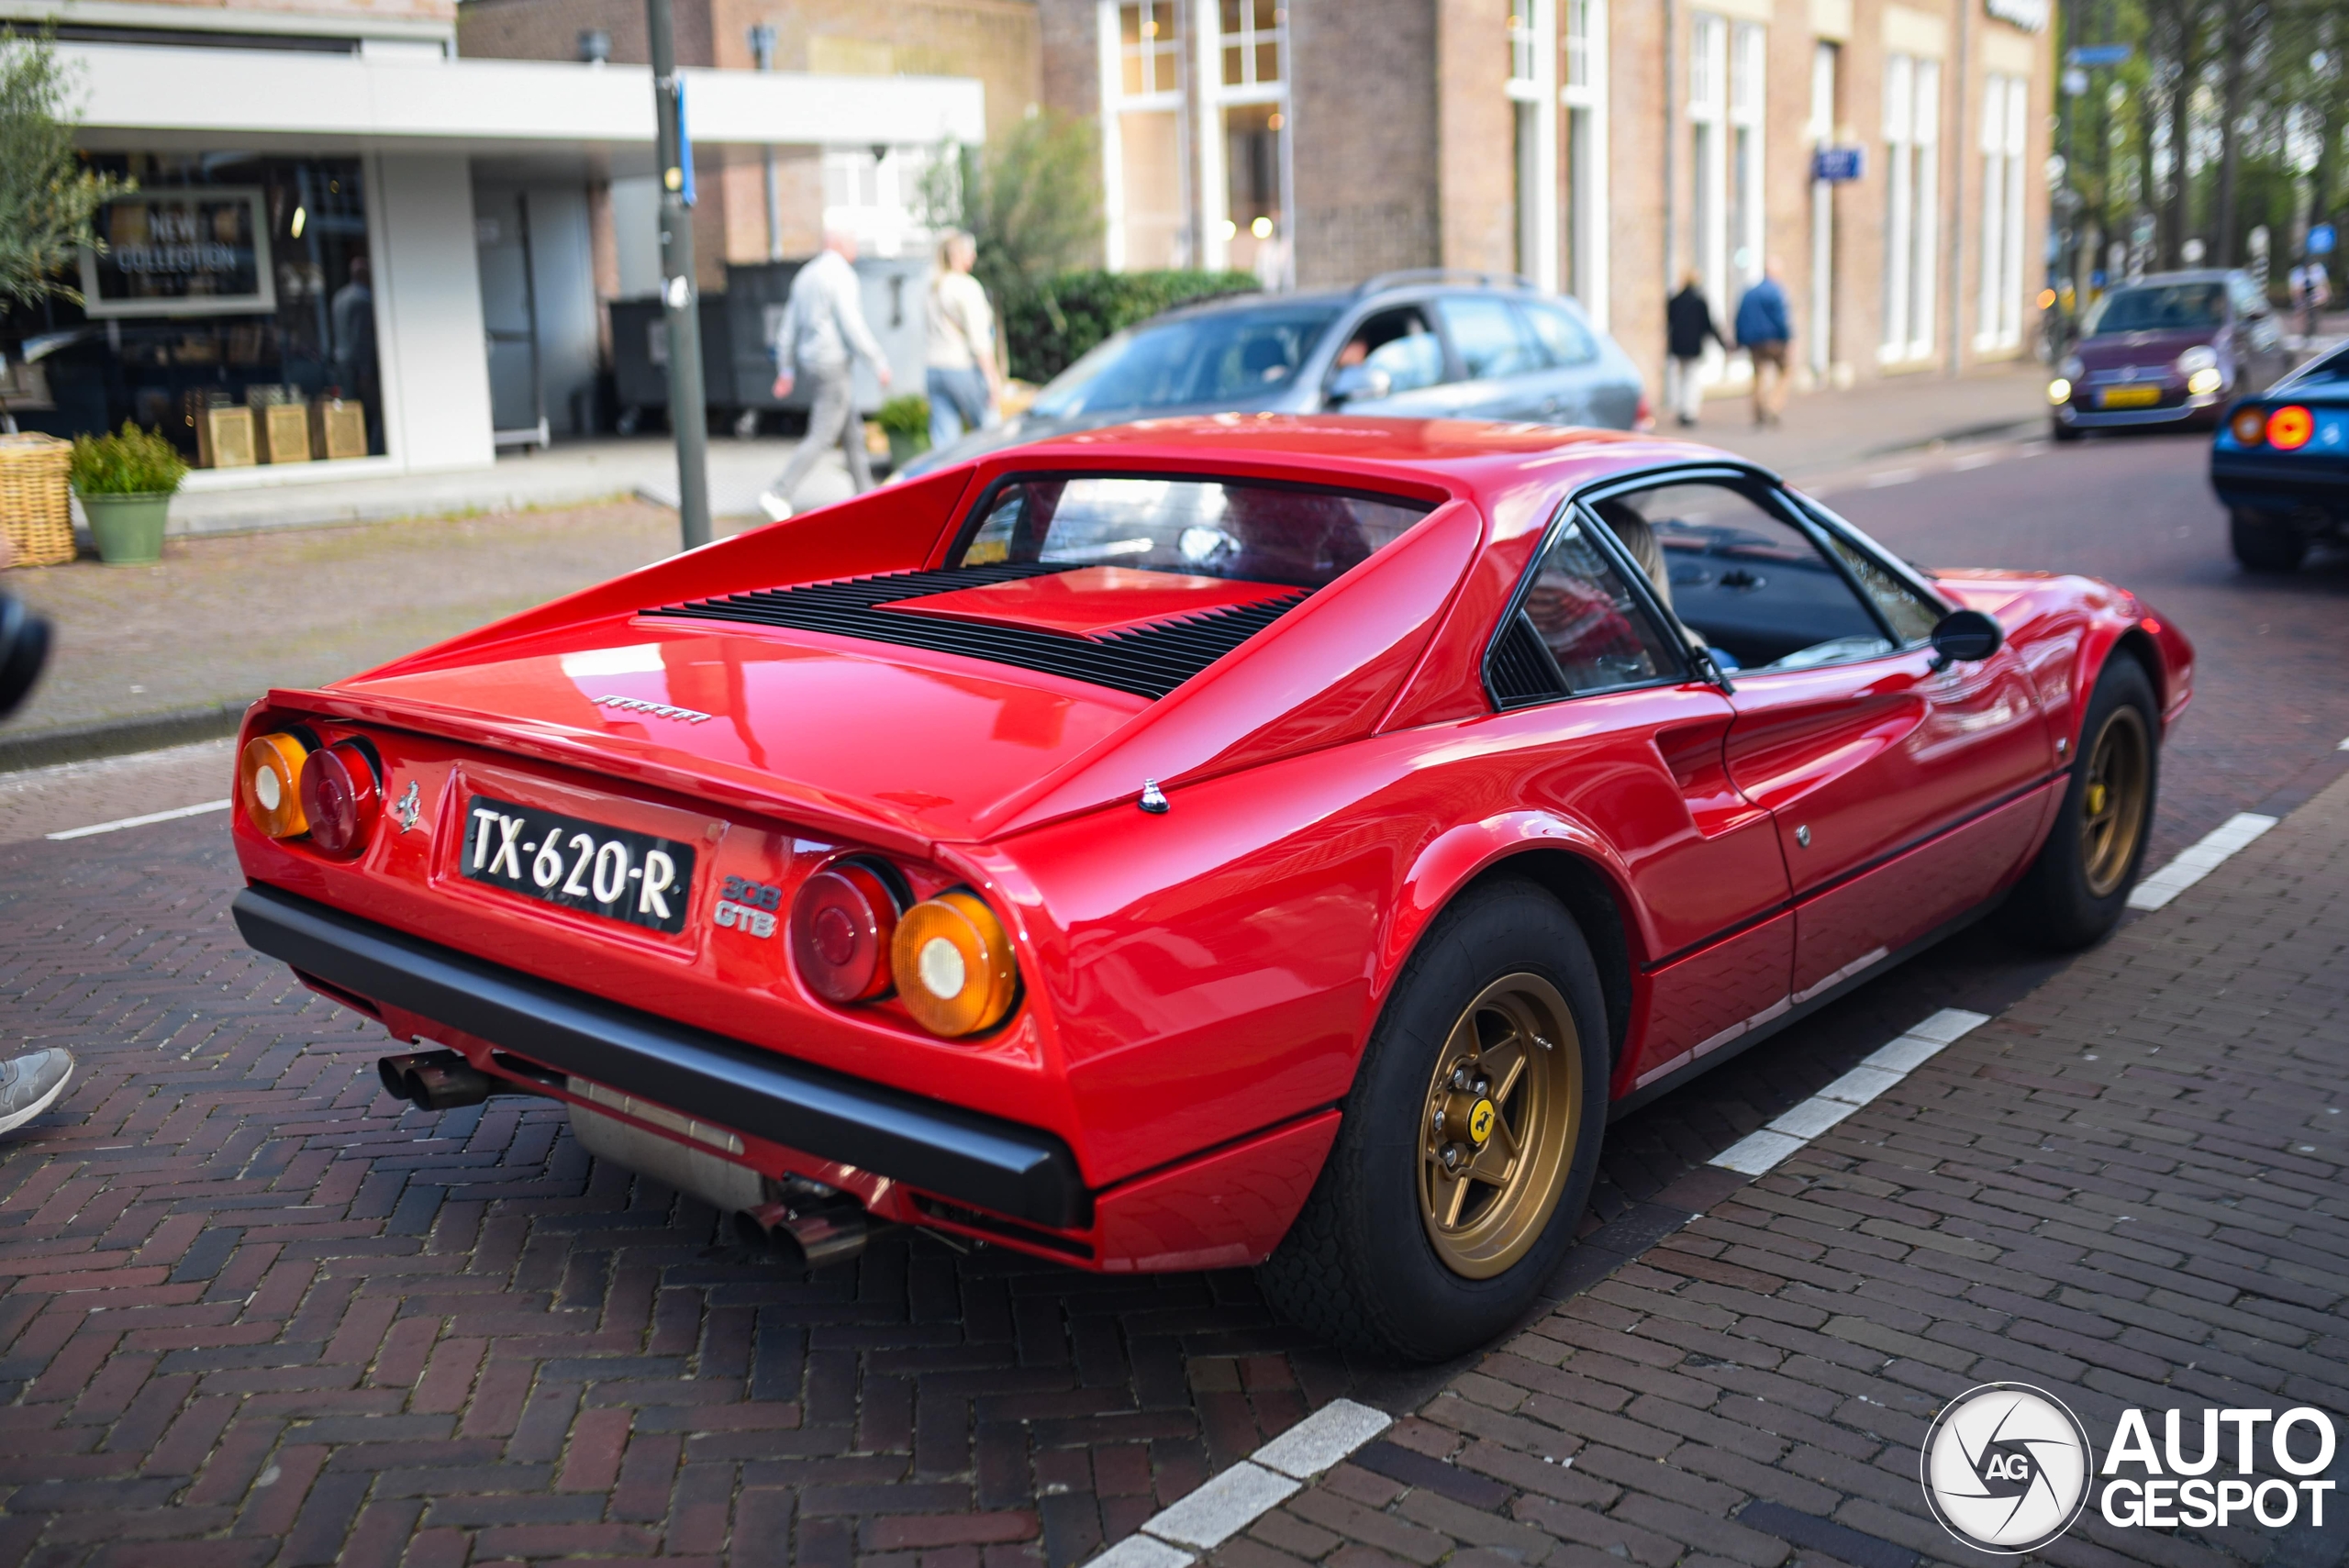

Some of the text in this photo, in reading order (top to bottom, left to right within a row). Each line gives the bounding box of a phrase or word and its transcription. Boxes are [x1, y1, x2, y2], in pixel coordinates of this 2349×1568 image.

[150, 212, 196, 242] NEW
[117, 244, 236, 274] COLLECTION
[473, 807, 676, 919] TX-620-R
[721, 874, 782, 911] 308
[713, 900, 776, 939] GTB
